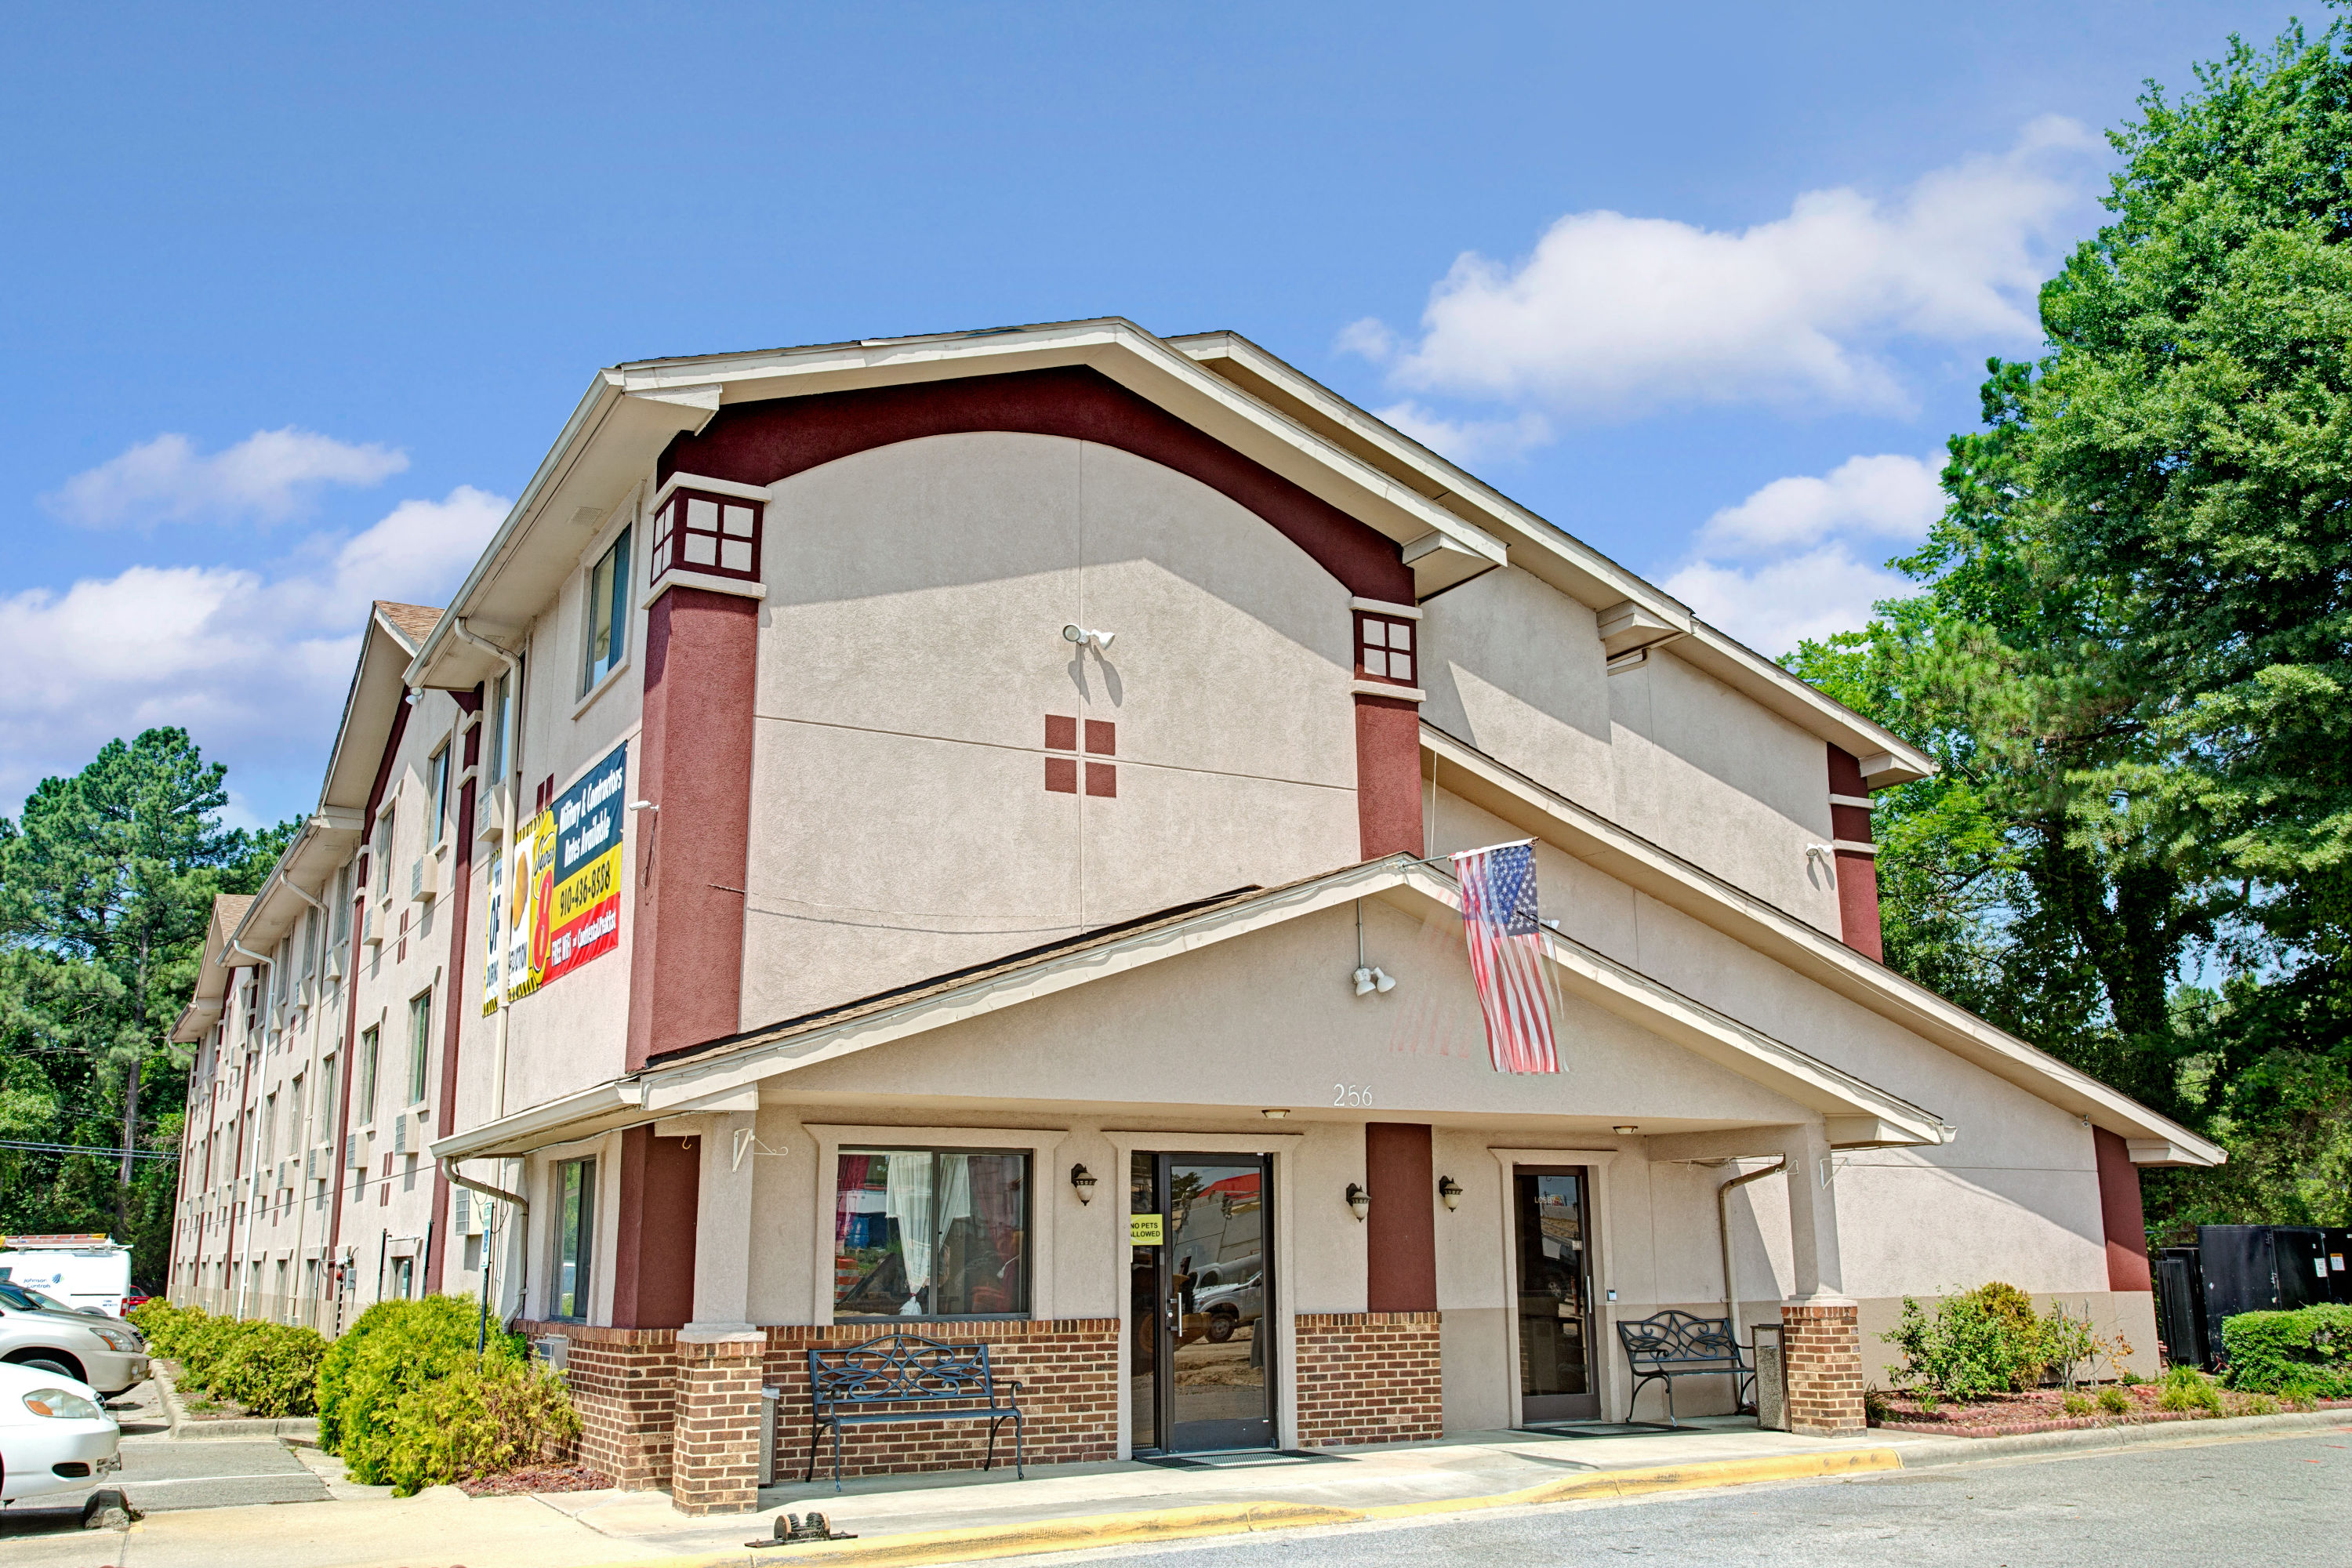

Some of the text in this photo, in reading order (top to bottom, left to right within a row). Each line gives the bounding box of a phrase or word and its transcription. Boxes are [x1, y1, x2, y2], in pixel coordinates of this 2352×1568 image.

[559, 767, 622, 837] Military & Contractors
[534, 833, 555, 883] Super
[564, 808, 611, 868] Rates Available
[560, 860, 611, 917] 910-436-8588
[533, 869, 553, 972] 8
[552, 938, 562, 967] FREE
[1334, 1083, 1373, 1107] 256
